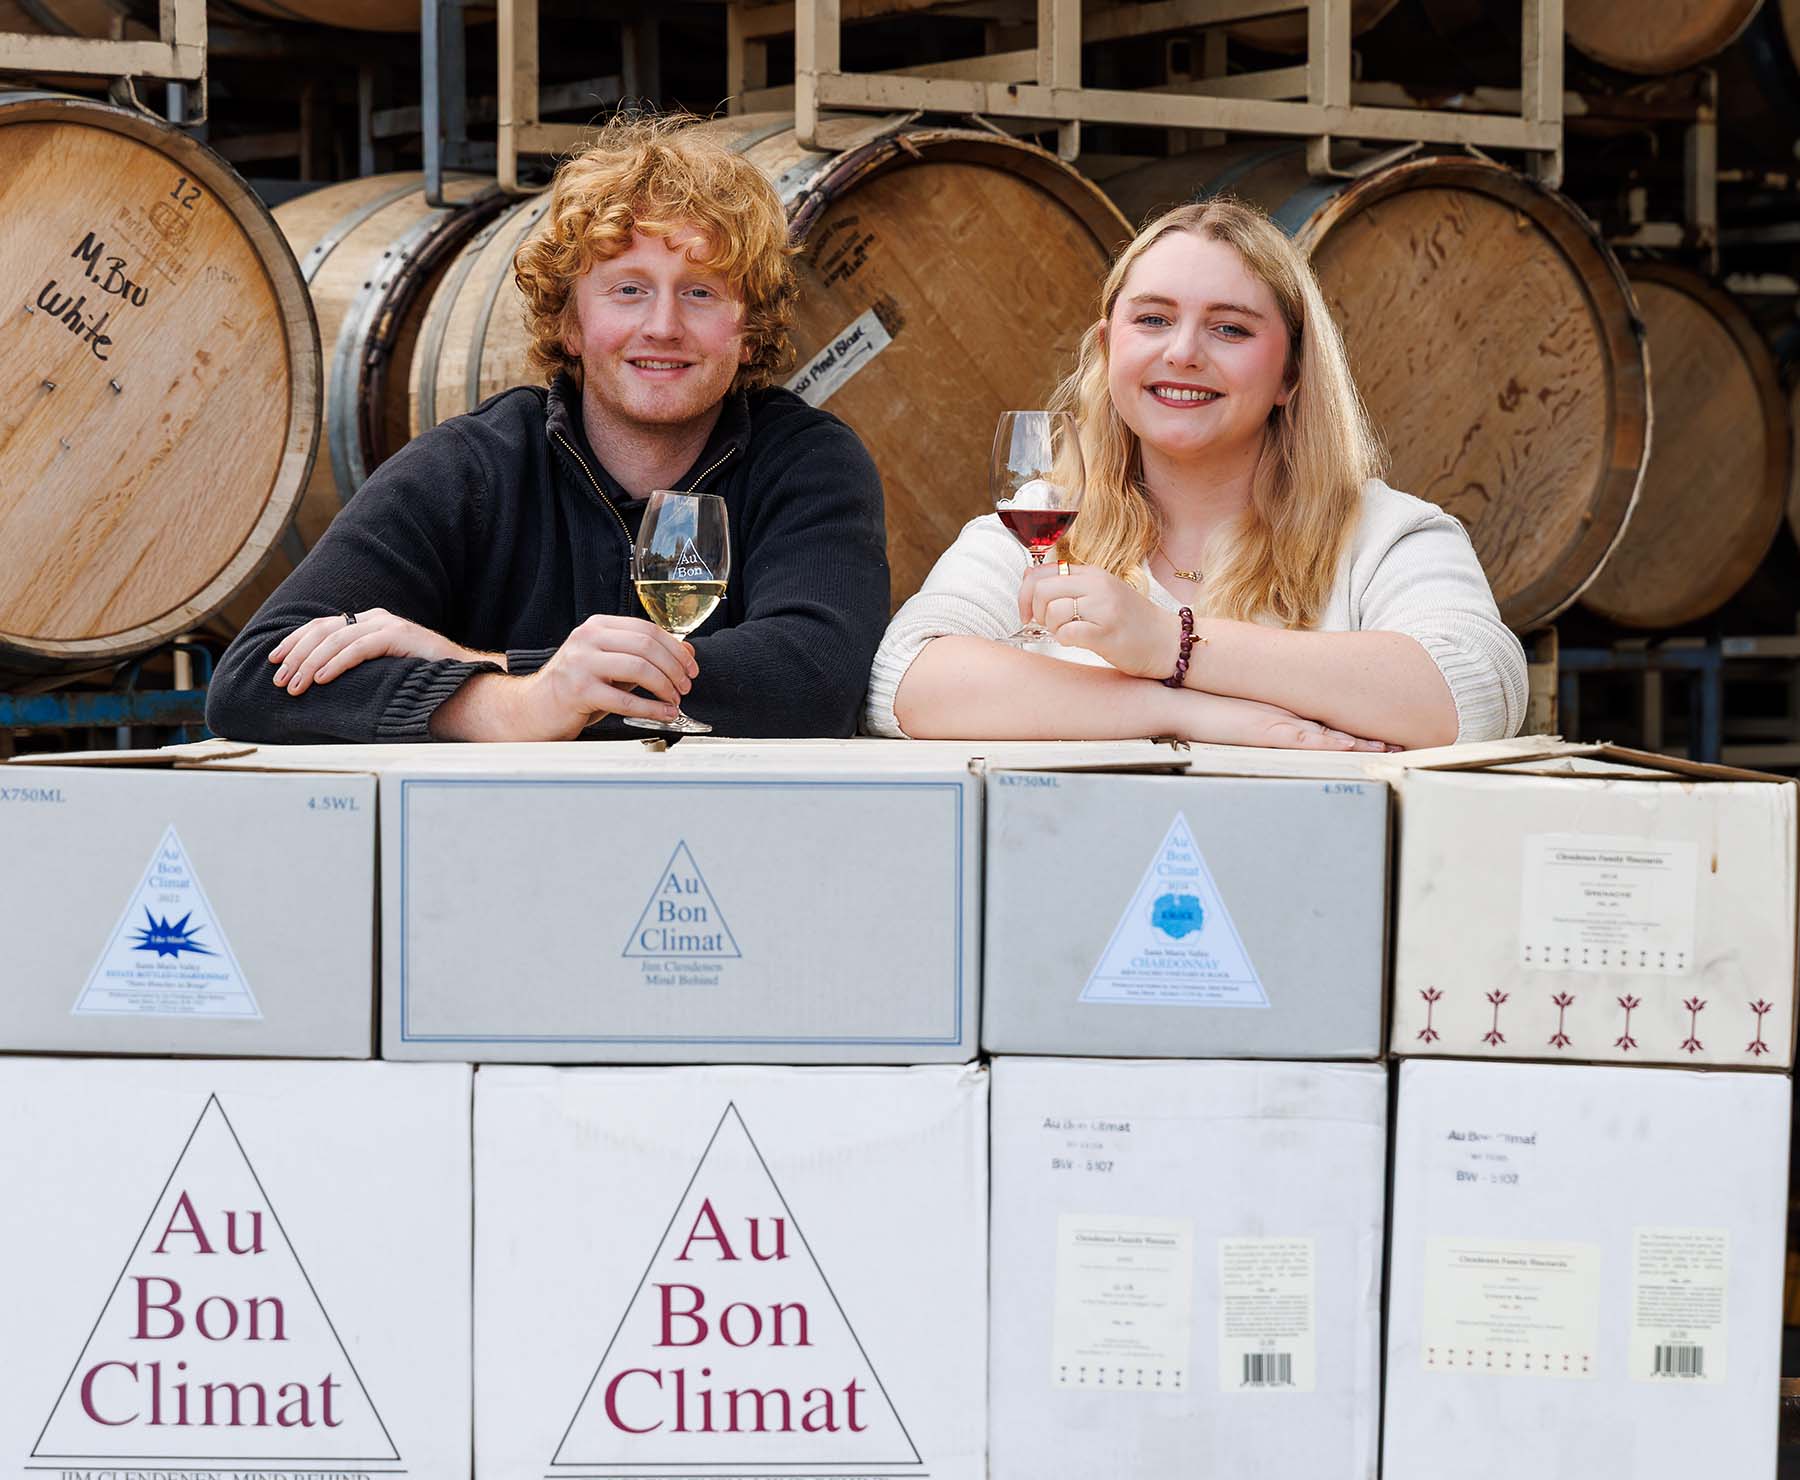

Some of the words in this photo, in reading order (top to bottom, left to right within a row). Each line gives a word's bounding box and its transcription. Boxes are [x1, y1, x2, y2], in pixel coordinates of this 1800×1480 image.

[170, 177, 203, 210] 12
[36, 280, 112, 361] White
[681, 553, 698, 565] Au
[677, 566, 703, 578] Bon
[307, 797, 360, 810] 4.5WL
[161, 849, 179, 860] Au
[1166, 851, 1192, 861] Bon
[157, 863, 183, 874] Bon
[1157, 864, 1199, 876] Climat
[149, 876, 190, 888] Climat
[663, 872, 698, 894] Au
[657, 900, 708, 922] Bon
[640, 928, 723, 951] Climat
[1130, 957, 1220, 969] CHARDONNAY
[646, 975, 675, 985] Mind
[678, 975, 719, 985] Behind
[1043, 1117, 1060, 1128] Au
[1447, 1130, 1465, 1141] Au
[1456, 1170, 1478, 1182] BW
[151, 1189, 268, 1255] Au
[674, 1197, 790, 1262] Au
[128, 1276, 290, 1341] Bon
[651, 1283, 813, 1348] Bon
[80, 1360, 343, 1428] Climat
[604, 1367, 868, 1434] Climat
